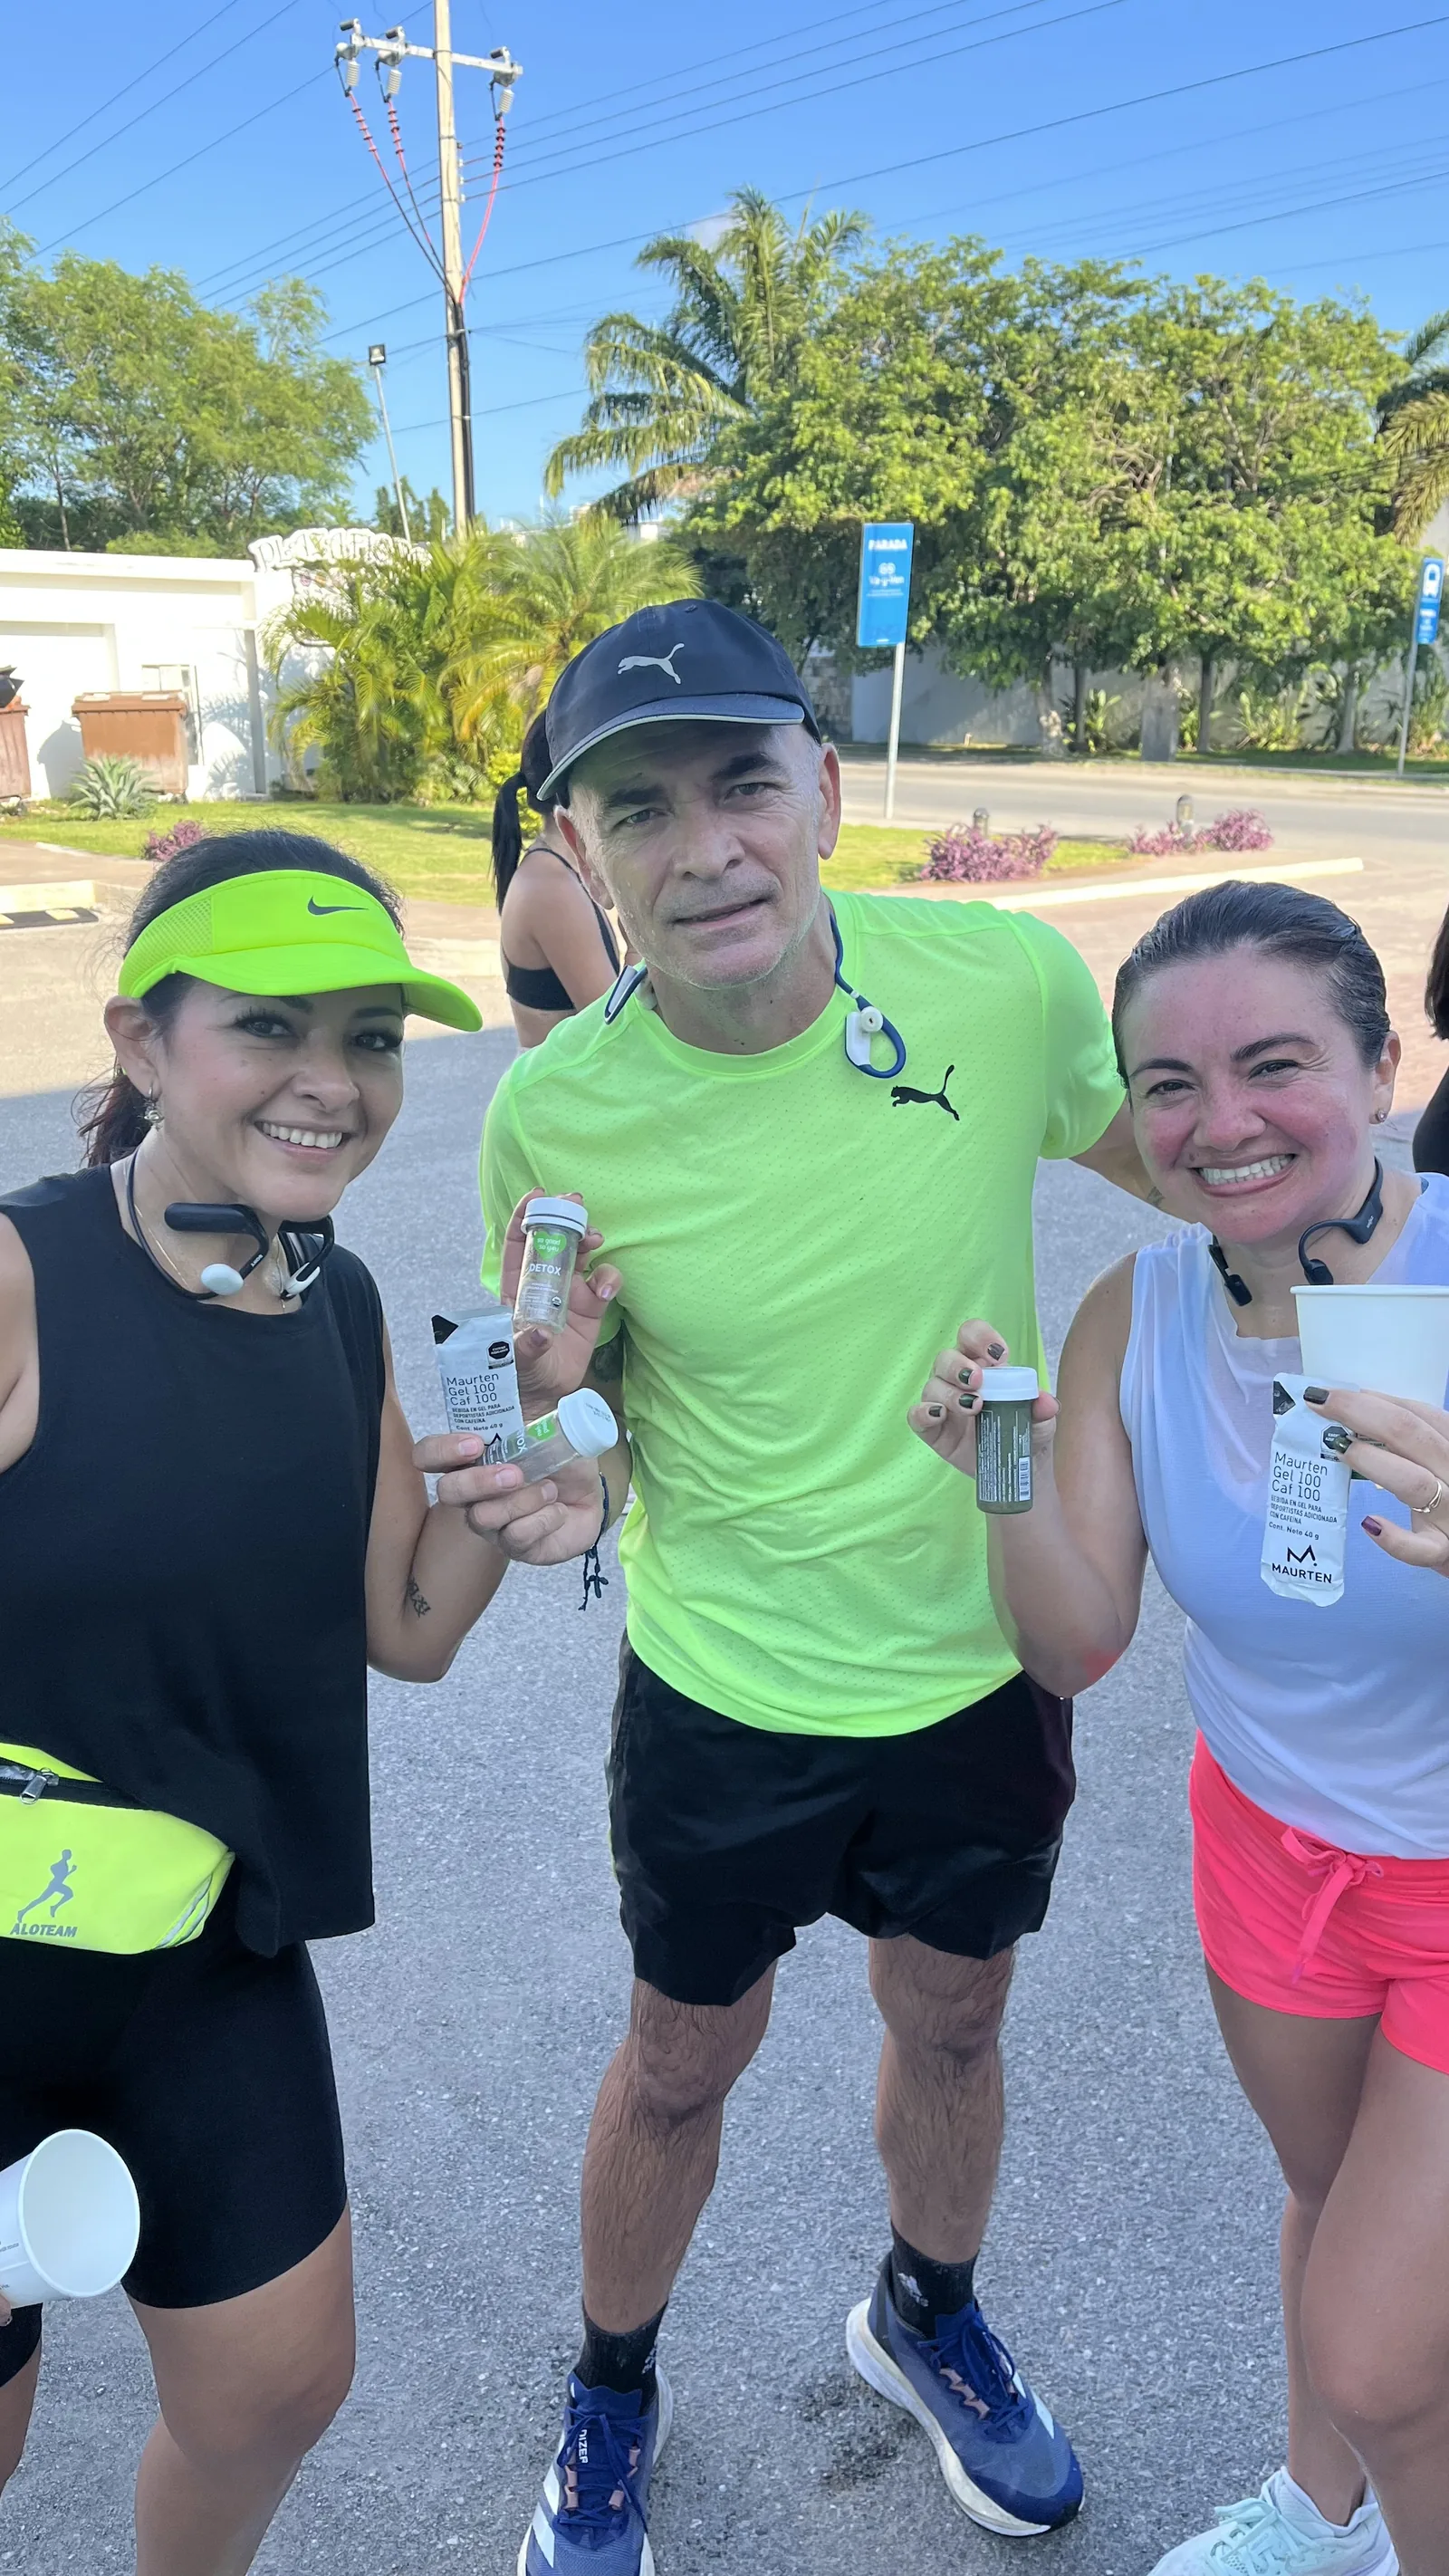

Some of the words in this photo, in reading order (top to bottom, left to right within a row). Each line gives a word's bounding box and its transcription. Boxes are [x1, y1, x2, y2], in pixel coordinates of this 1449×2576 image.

[868, 539, 908, 551] PARADA
[529, 1264, 561, 1276] DETOX
[446, 1373, 499, 1386] Maurten
[448, 1387, 469, 1396] Gel
[474, 1382, 495, 1394] 100
[450, 1396, 471, 1406] Caf
[475, 1392, 497, 1404] 100
[1274, 1452, 1328, 1476] Maurten
[1273, 1466, 1293, 1482] Gel
[1298, 1472, 1320, 1488] 100
[1271, 1479, 1293, 1495] Caf
[1297, 1485, 1320, 1502] 100
[1271, 1495, 1288, 1504] BEBIDA
[1298, 1501, 1307, 1510] GEL
[1308, 1504, 1322, 1513] PARA
[1270, 1510, 1280, 1519] CON
[1271, 1503, 1303, 1517] DEPORTISTAS
[1304, 1511, 1338, 1523] ADICIONADA
[1286, 1526, 1303, 1536] Neto
[1304, 1530, 1313, 1538] 40
[1271, 1562, 1332, 1584] MAURTEN
[10, 1923, 78, 1937] ALOTEAM
